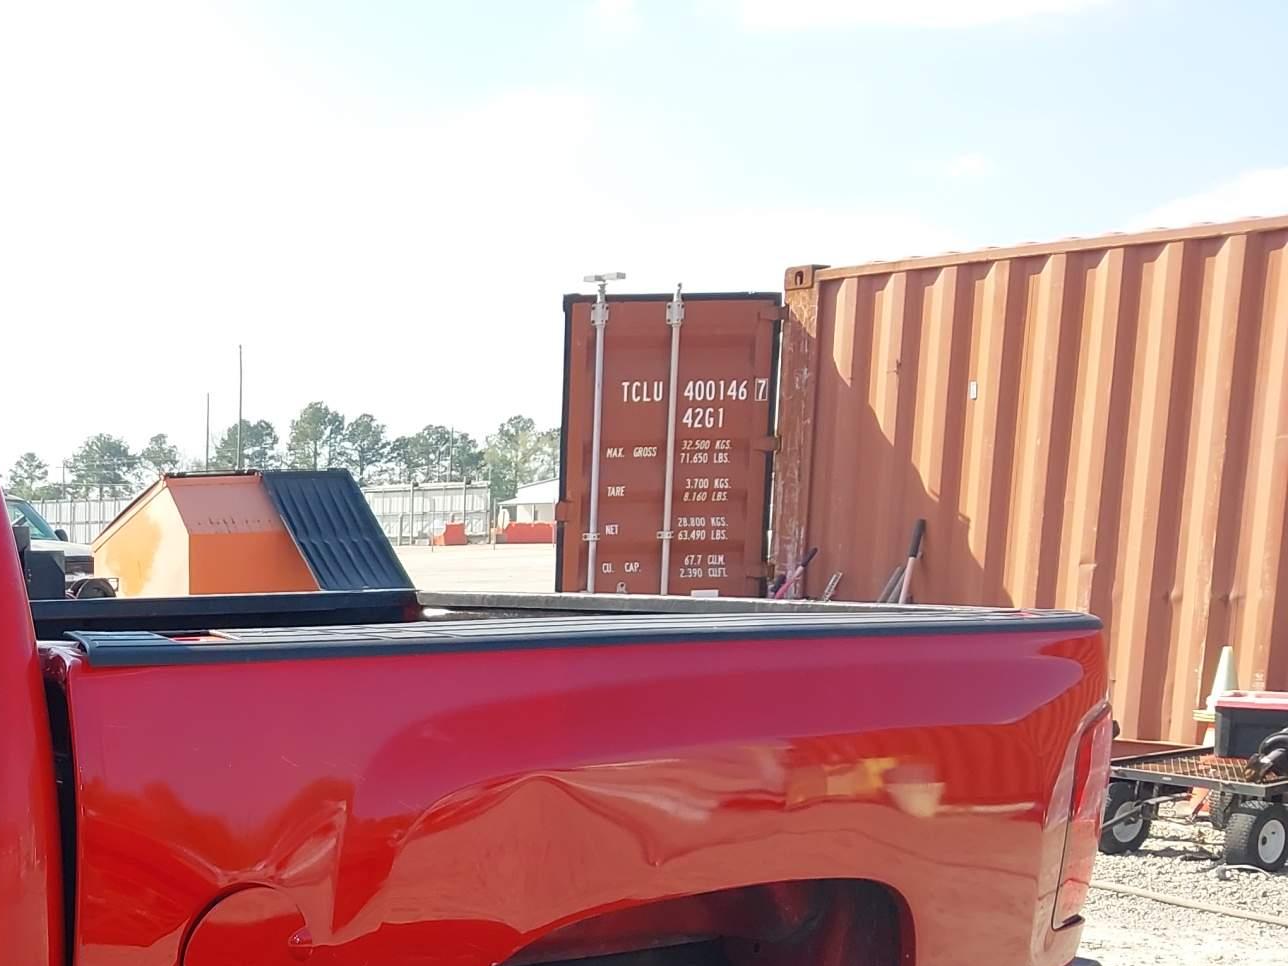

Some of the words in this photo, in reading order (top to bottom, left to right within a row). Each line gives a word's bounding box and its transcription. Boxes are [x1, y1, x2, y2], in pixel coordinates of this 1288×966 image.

[621, 381, 664, 402] TCLU
[683, 380, 748, 401] 400146
[757, 380, 766, 399] 7
[682, 408, 725, 428] 42G1
[714, 440, 732, 449] KGS.
[606, 447, 624, 458] MAX.
[633, 447, 658, 458] GROSS
[713, 453, 730, 463] LBS.
[685, 478, 709, 489] 3.700
[713, 478, 732, 488] KGS.
[607, 486, 626, 497] TARE
[711, 491, 728, 501] LBS.
[711, 517, 729, 527] KGS.
[605, 524, 619, 535] NET
[711, 530, 728, 540] LBS.
[602, 563, 615, 573] CU.
[624, 562, 641, 573] CAP.
[679, 567, 703, 577] 2.390
